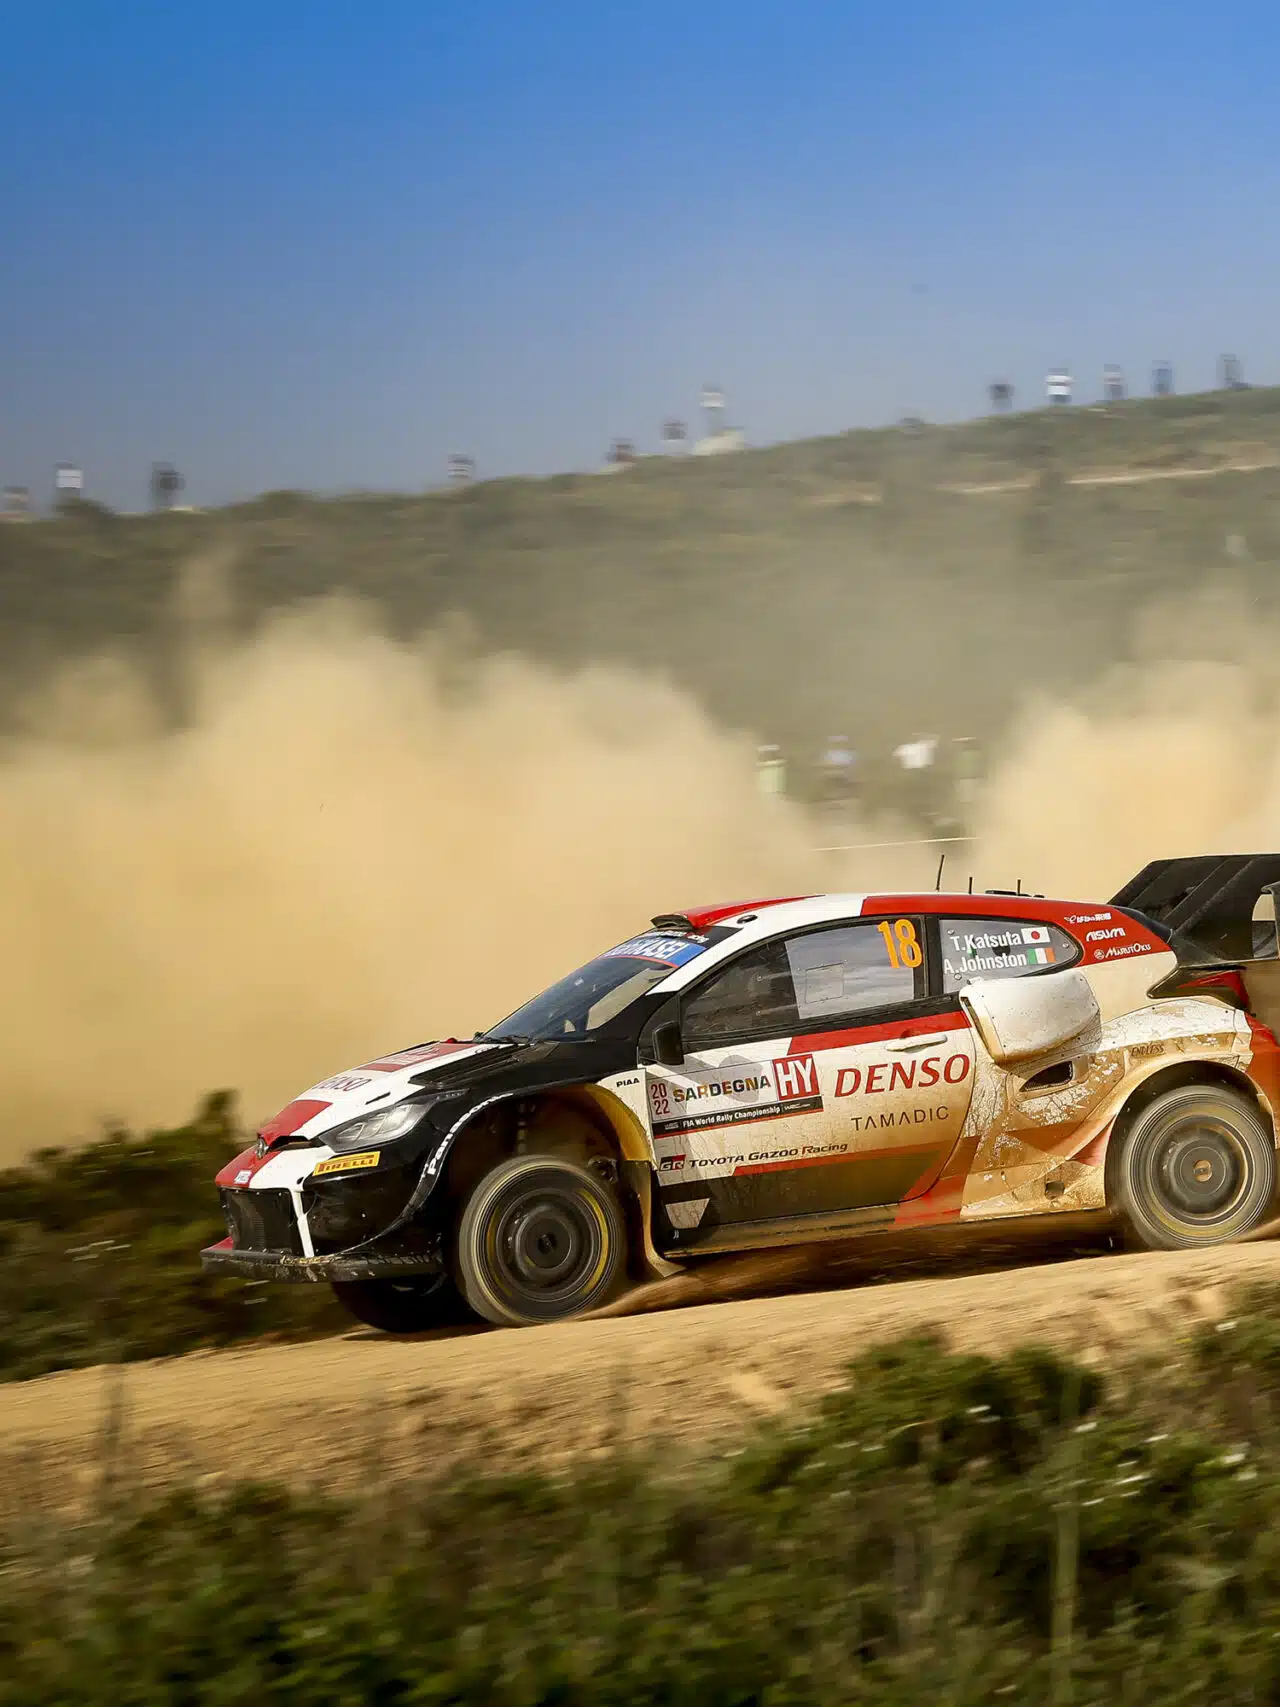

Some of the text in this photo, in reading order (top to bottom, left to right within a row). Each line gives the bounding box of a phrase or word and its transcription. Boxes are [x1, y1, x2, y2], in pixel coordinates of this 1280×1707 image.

[877, 918, 923, 969] 18
[950, 932, 1022, 952] T.Katsuta
[943, 953, 1028, 974] A.Johnston
[1131, 1042, 1165, 1057] ENDLESS
[616, 1077, 640, 1088] PIAA
[775, 1057, 813, 1097] HY
[834, 1053, 970, 1098] DENSO
[651, 1082, 667, 1099] 20
[673, 1075, 772, 1103] SARDEGNA
[654, 1099, 671, 1116] 22
[682, 1118, 695, 1129] FIA
[695, 1116, 715, 1127] World
[716, 1113, 733, 1124] Rally
[734, 1106, 781, 1120] Championship
[851, 1105, 949, 1131] TAMADIC
[317, 1154, 376, 1173] PIRELLI
[660, 1143, 849, 1172] GR TOYOTA GAZOO Racing
